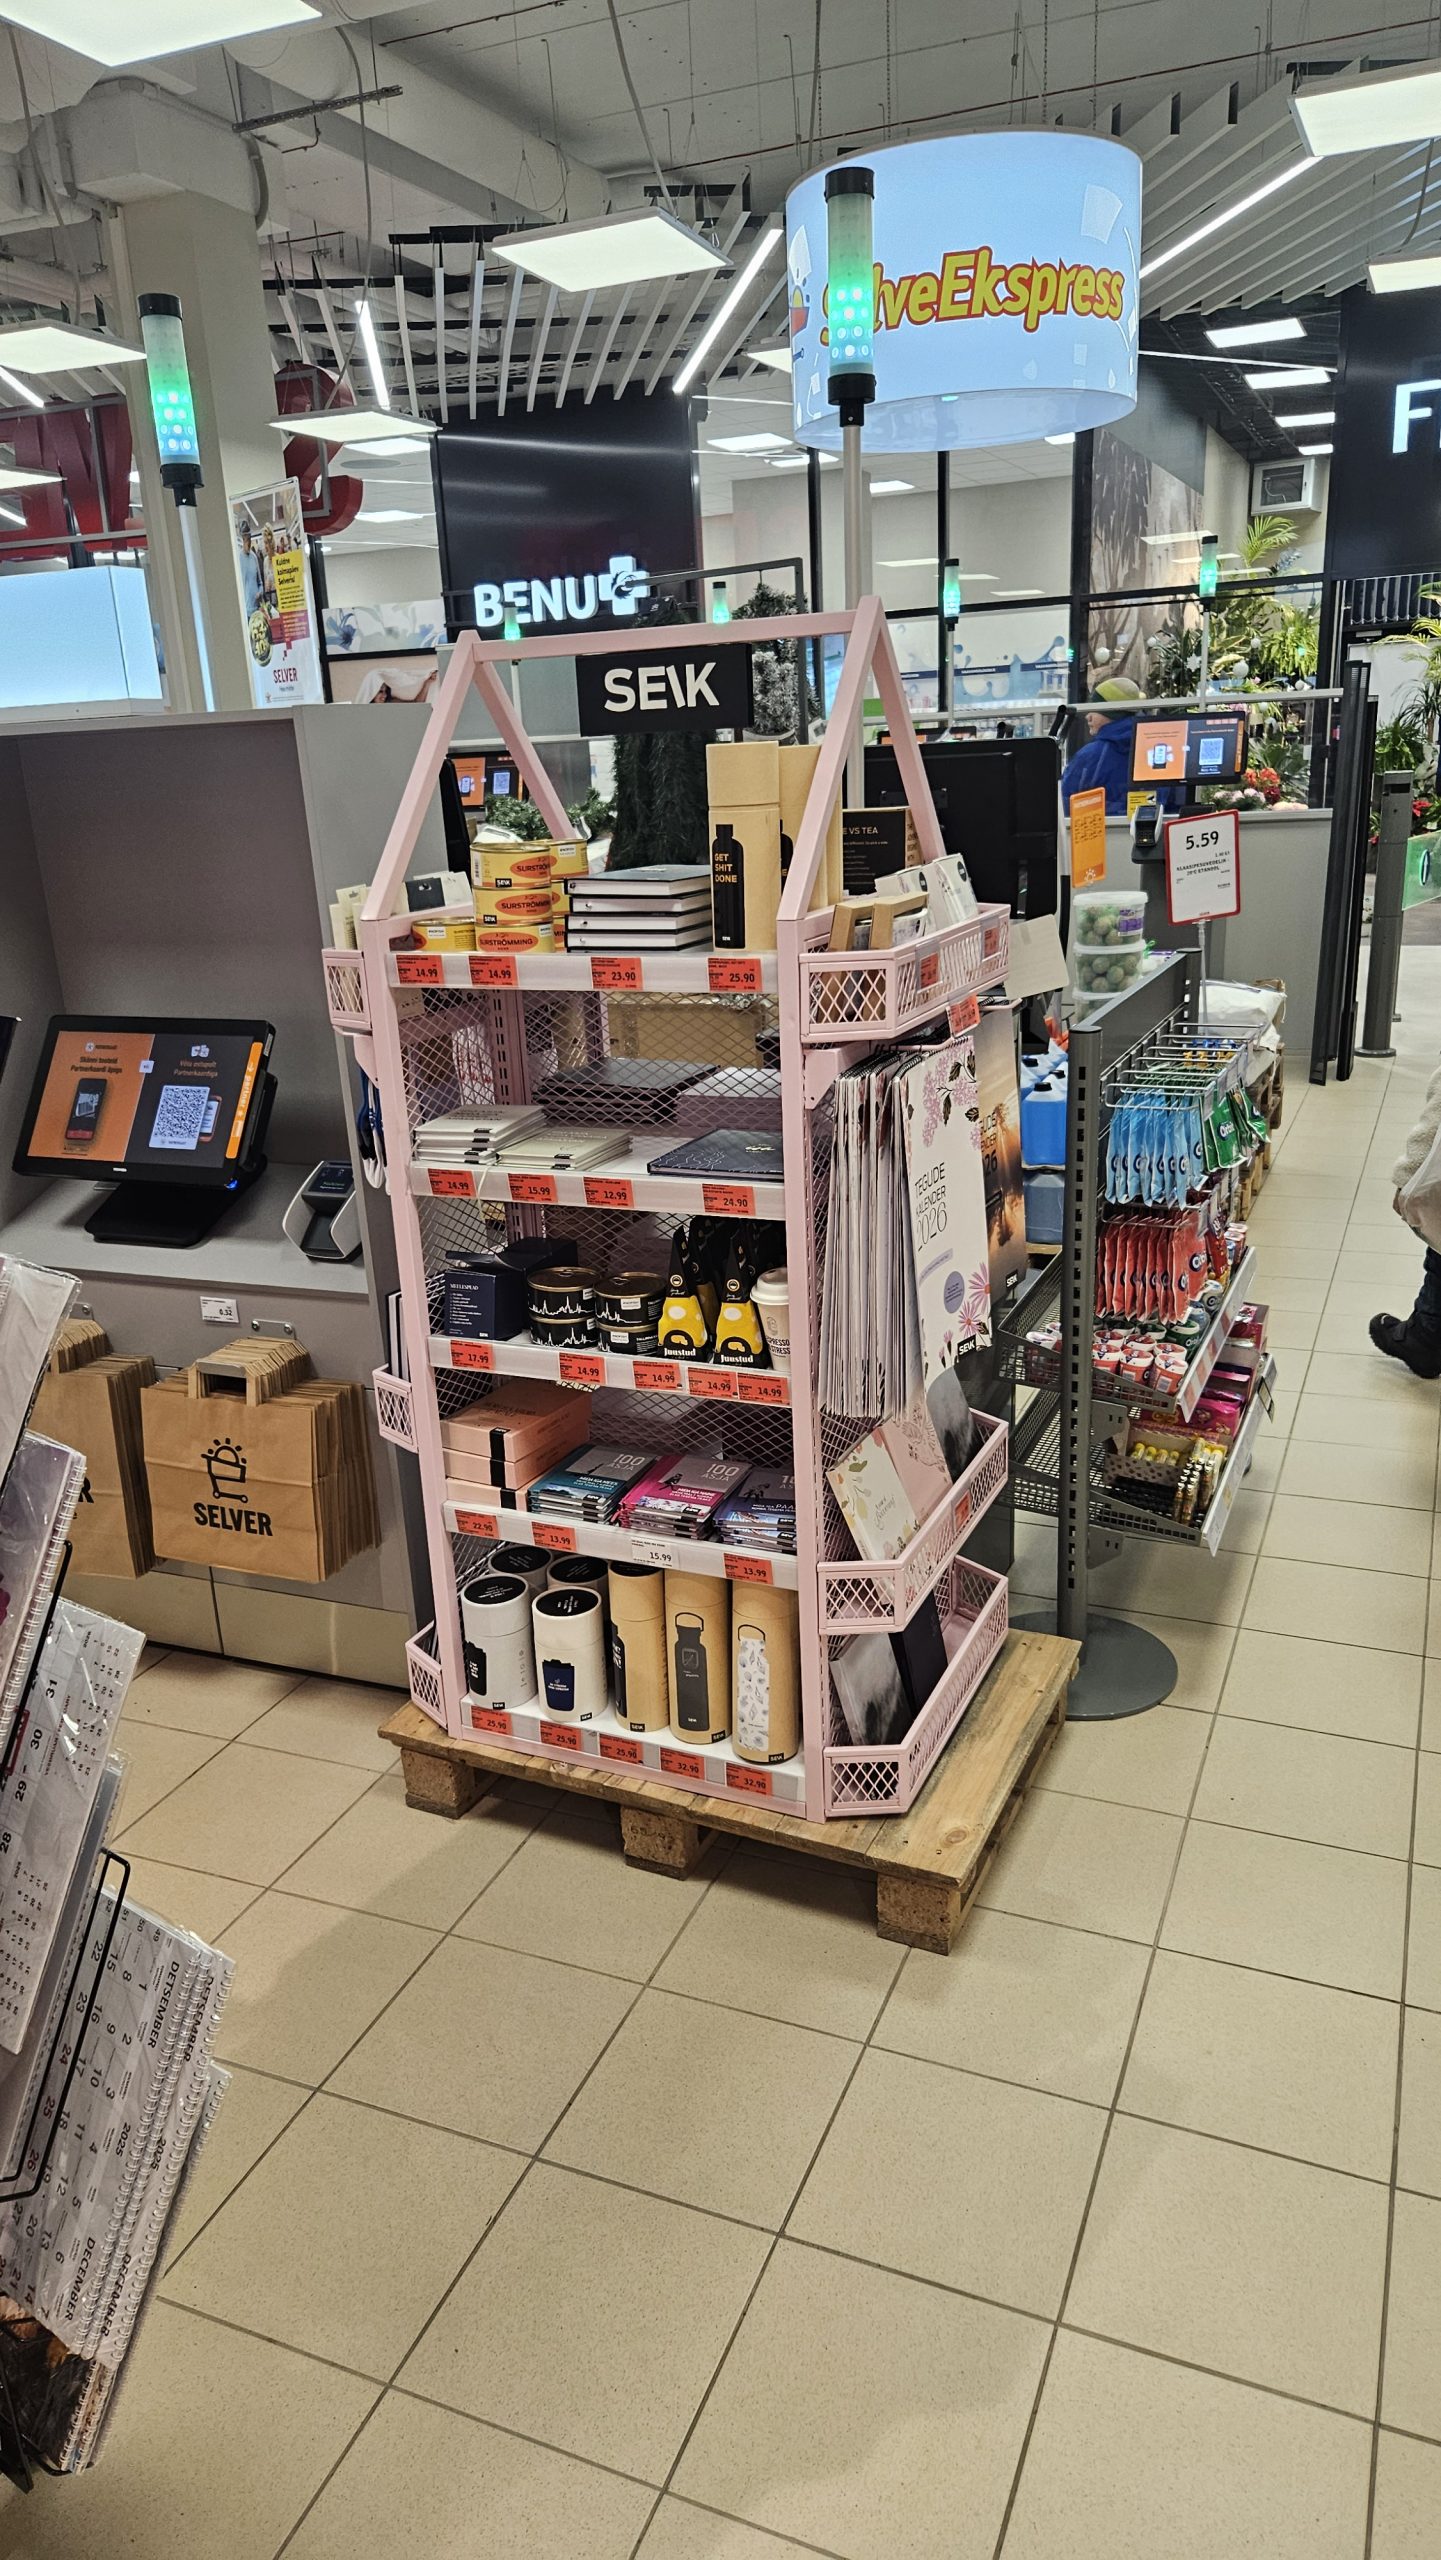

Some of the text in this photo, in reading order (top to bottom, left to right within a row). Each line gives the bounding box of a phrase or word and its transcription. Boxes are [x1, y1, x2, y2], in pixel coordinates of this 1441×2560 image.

[820, 246, 1125, 346] lveEkspress
[1392, 379, 1441, 454] F
[474, 575, 598, 628] BENU
[273, 667, 299, 683] SELVER
[862, 826, 878, 834] TEA
[1186, 831, 1219, 850] 5.59
[714, 853, 729, 862] GET
[715, 863, 733, 872] SHIT
[715, 875, 738, 883] DONE
[416, 968, 438, 978] 14.99
[489, 970, 511, 979] 14.99
[611, 971, 636, 981] 23.90
[729, 973, 755, 983] 25.90
[984, 1151, 998, 1177] 26
[915, 1162, 945, 1198] TEGUDE
[528, 1187, 550, 1195] 15.99
[604, 1191, 627, 1200] 12.99
[723, 1198, 748, 1207] 24.90
[917, 1201, 947, 1252] 2026
[468, 1354, 489, 1363] 17.99
[664, 1347, 696, 1357] Juustud
[721, 1355, 754, 1364] Juustud
[578, 1367, 599, 1376] 14.99
[653, 1374, 675, 1383] 14.99
[707, 1382, 731, 1391] 14.99
[758, 1388, 782, 1397] 14.99
[614, 1453, 645, 1466] 100
[706, 1463, 739, 1476] 100
[701, 1473, 730, 1482] ASJA
[193, 1502, 273, 1537] SELVER
[550, 1535, 571, 1544] 13.99
[650, 1552, 672, 1561] 15.99
[744, 1567, 767, 1577] 13.99
[45, 1679, 58, 1699] 31
[30, 1728, 43, 1750] 30
[616, 1748, 637, 1759] 25.90
[678, 1762, 699, 1773] 32.90
[15, 1780, 27, 1802] 29
[121, 1908, 129, 1922] 51
[137, 1920, 146, 1932] 50
[152, 1928, 161, 1942] 49
[91, 1940, 103, 1962] 22
[107, 1953, 118, 1972] 15
[122, 1969, 132, 1982] 8
[138, 1983, 148, 1992] 1
[75, 1991, 88, 2014] 23
[147, 1961, 180, 2049] DETSEMBER
[91, 2004, 103, 2024] 16
[107, 2022, 116, 2035] 9
[121, 2033, 132, 2046] 2
[59, 2043, 72, 2066] 24
[75, 2056, 87, 2078] 17
[90, 2067, 102, 2088] 10
[105, 2087, 116, 2100] 3
[43, 2095, 55, 2120] 25
[59, 2109, 71, 2130] 18
[74, 2122, 86, 2141] 11
[115, 2122, 131, 2157] 2025
[89, 2142, 98, 2155] 4
[27, 2149, 39, 2172] 26
[56, 2176, 69, 2197] 12
[72, 2196, 82, 2210] 5
[12, 2202, 23, 2226] 27
[26, 2214, 38, 2238] 20
[41, 2229, 52, 2250] 13
[56, 2251, 65, 2265] 6
[9, 2267, 22, 2290] 21
[65, 2237, 96, 2321] DECEMBER
[24, 2284, 36, 2305] 14
[41, 2307, 49, 2320] 7
